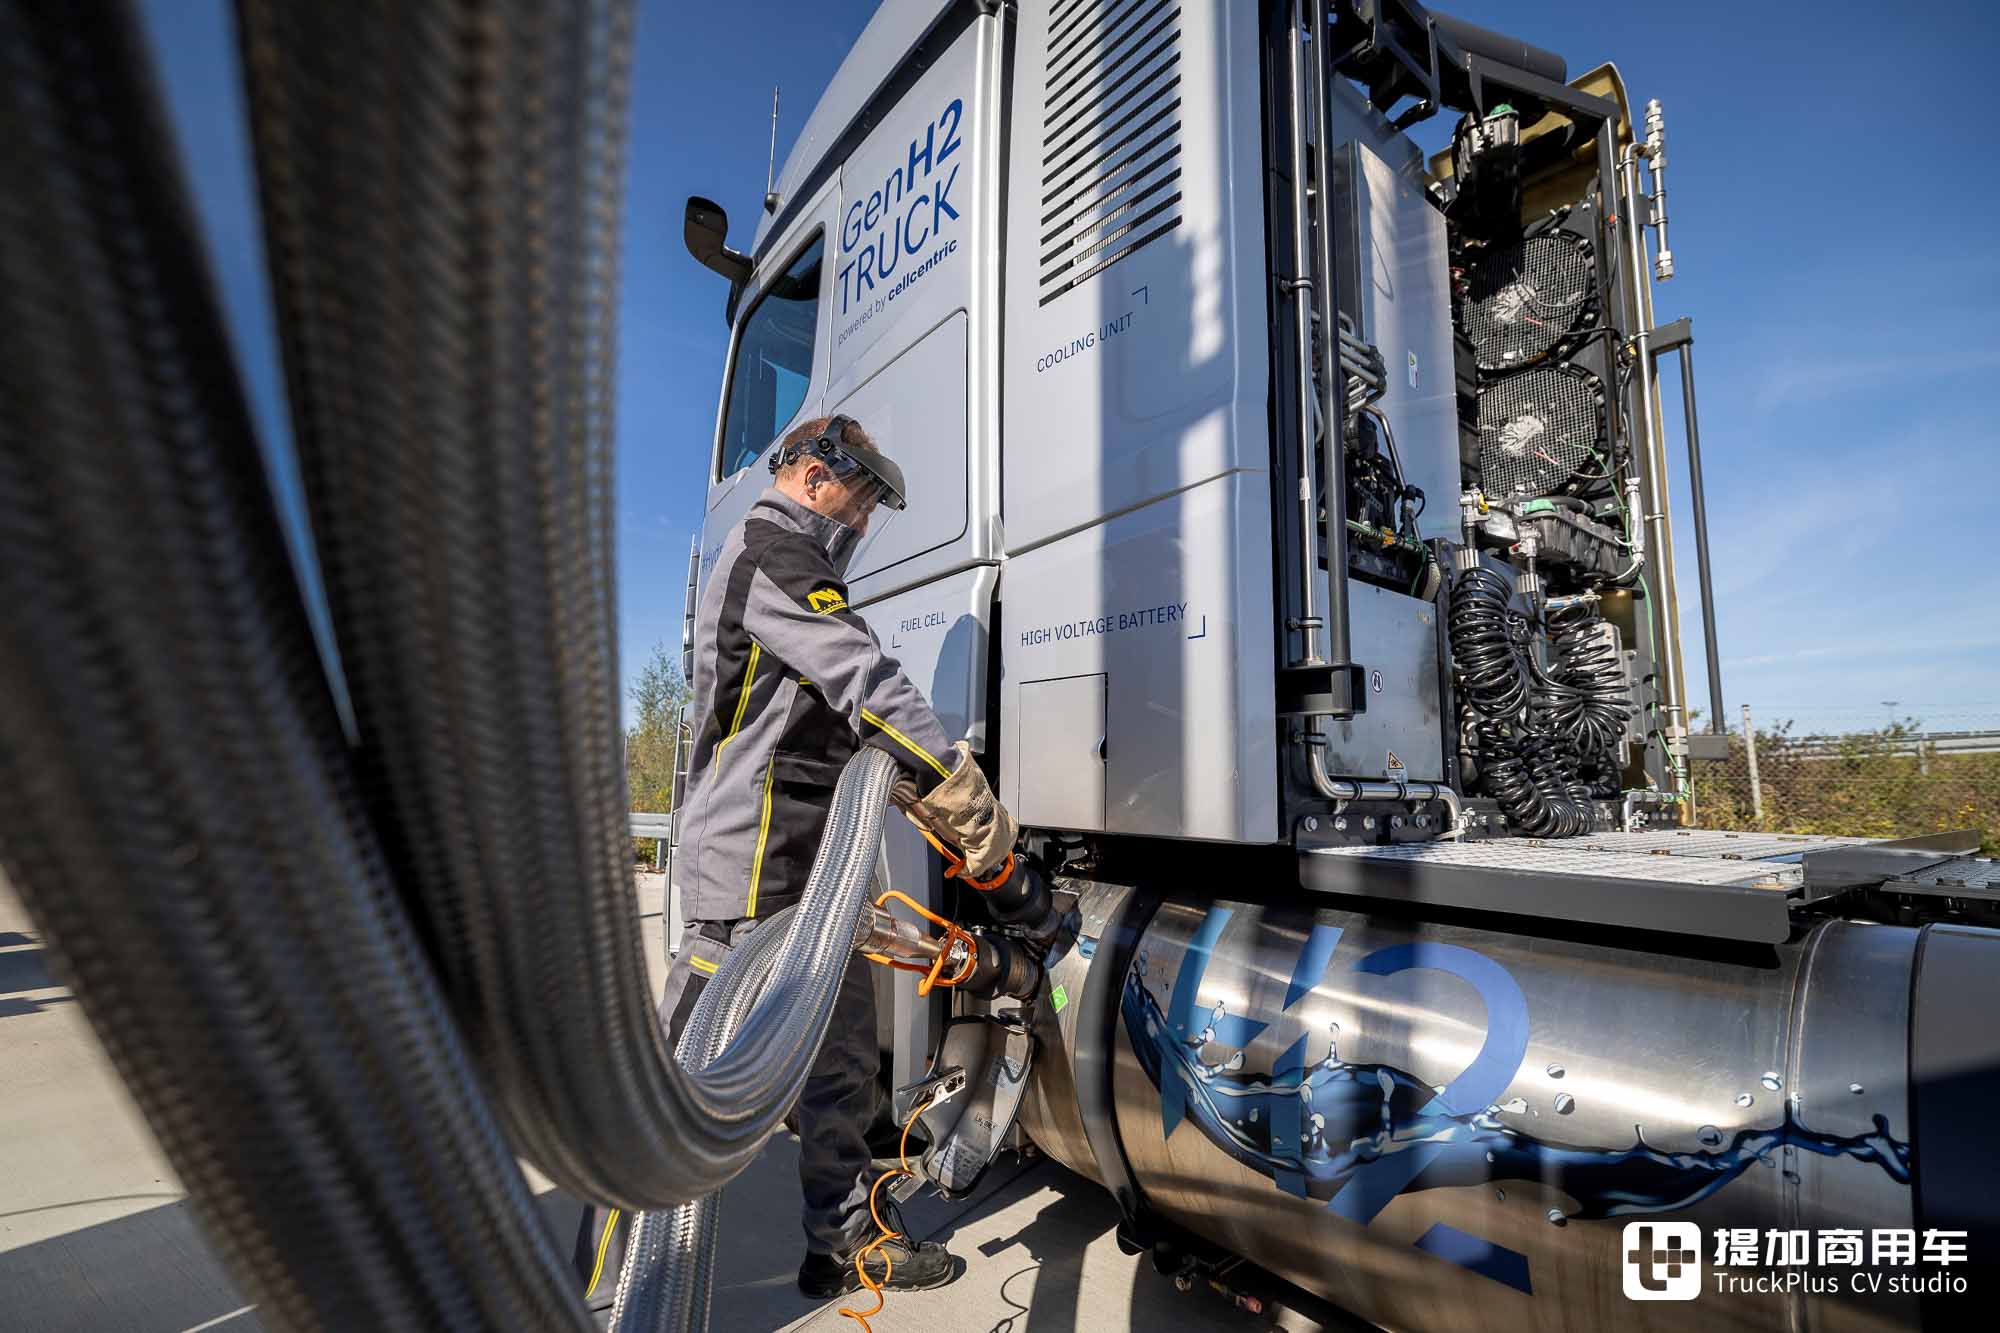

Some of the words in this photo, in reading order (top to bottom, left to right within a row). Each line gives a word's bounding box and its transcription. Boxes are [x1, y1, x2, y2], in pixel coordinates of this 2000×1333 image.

[842, 98, 963, 254] GenH2
[839, 162, 961, 314] TRUCK
[838, 304, 873, 348] powered
[875, 295, 887, 312] by
[888, 239, 957, 301] cellcentric
[1037, 332, 1095, 373] COOLING
[1099, 311, 1134, 341] UNIT
[901, 615, 922, 633] FUEL
[924, 610, 947, 628] CELL
[1020, 627, 1051, 647] HIGH
[1055, 615, 1114, 640] VOLTAGE
[1119, 602, 1189, 630] BATTERY
